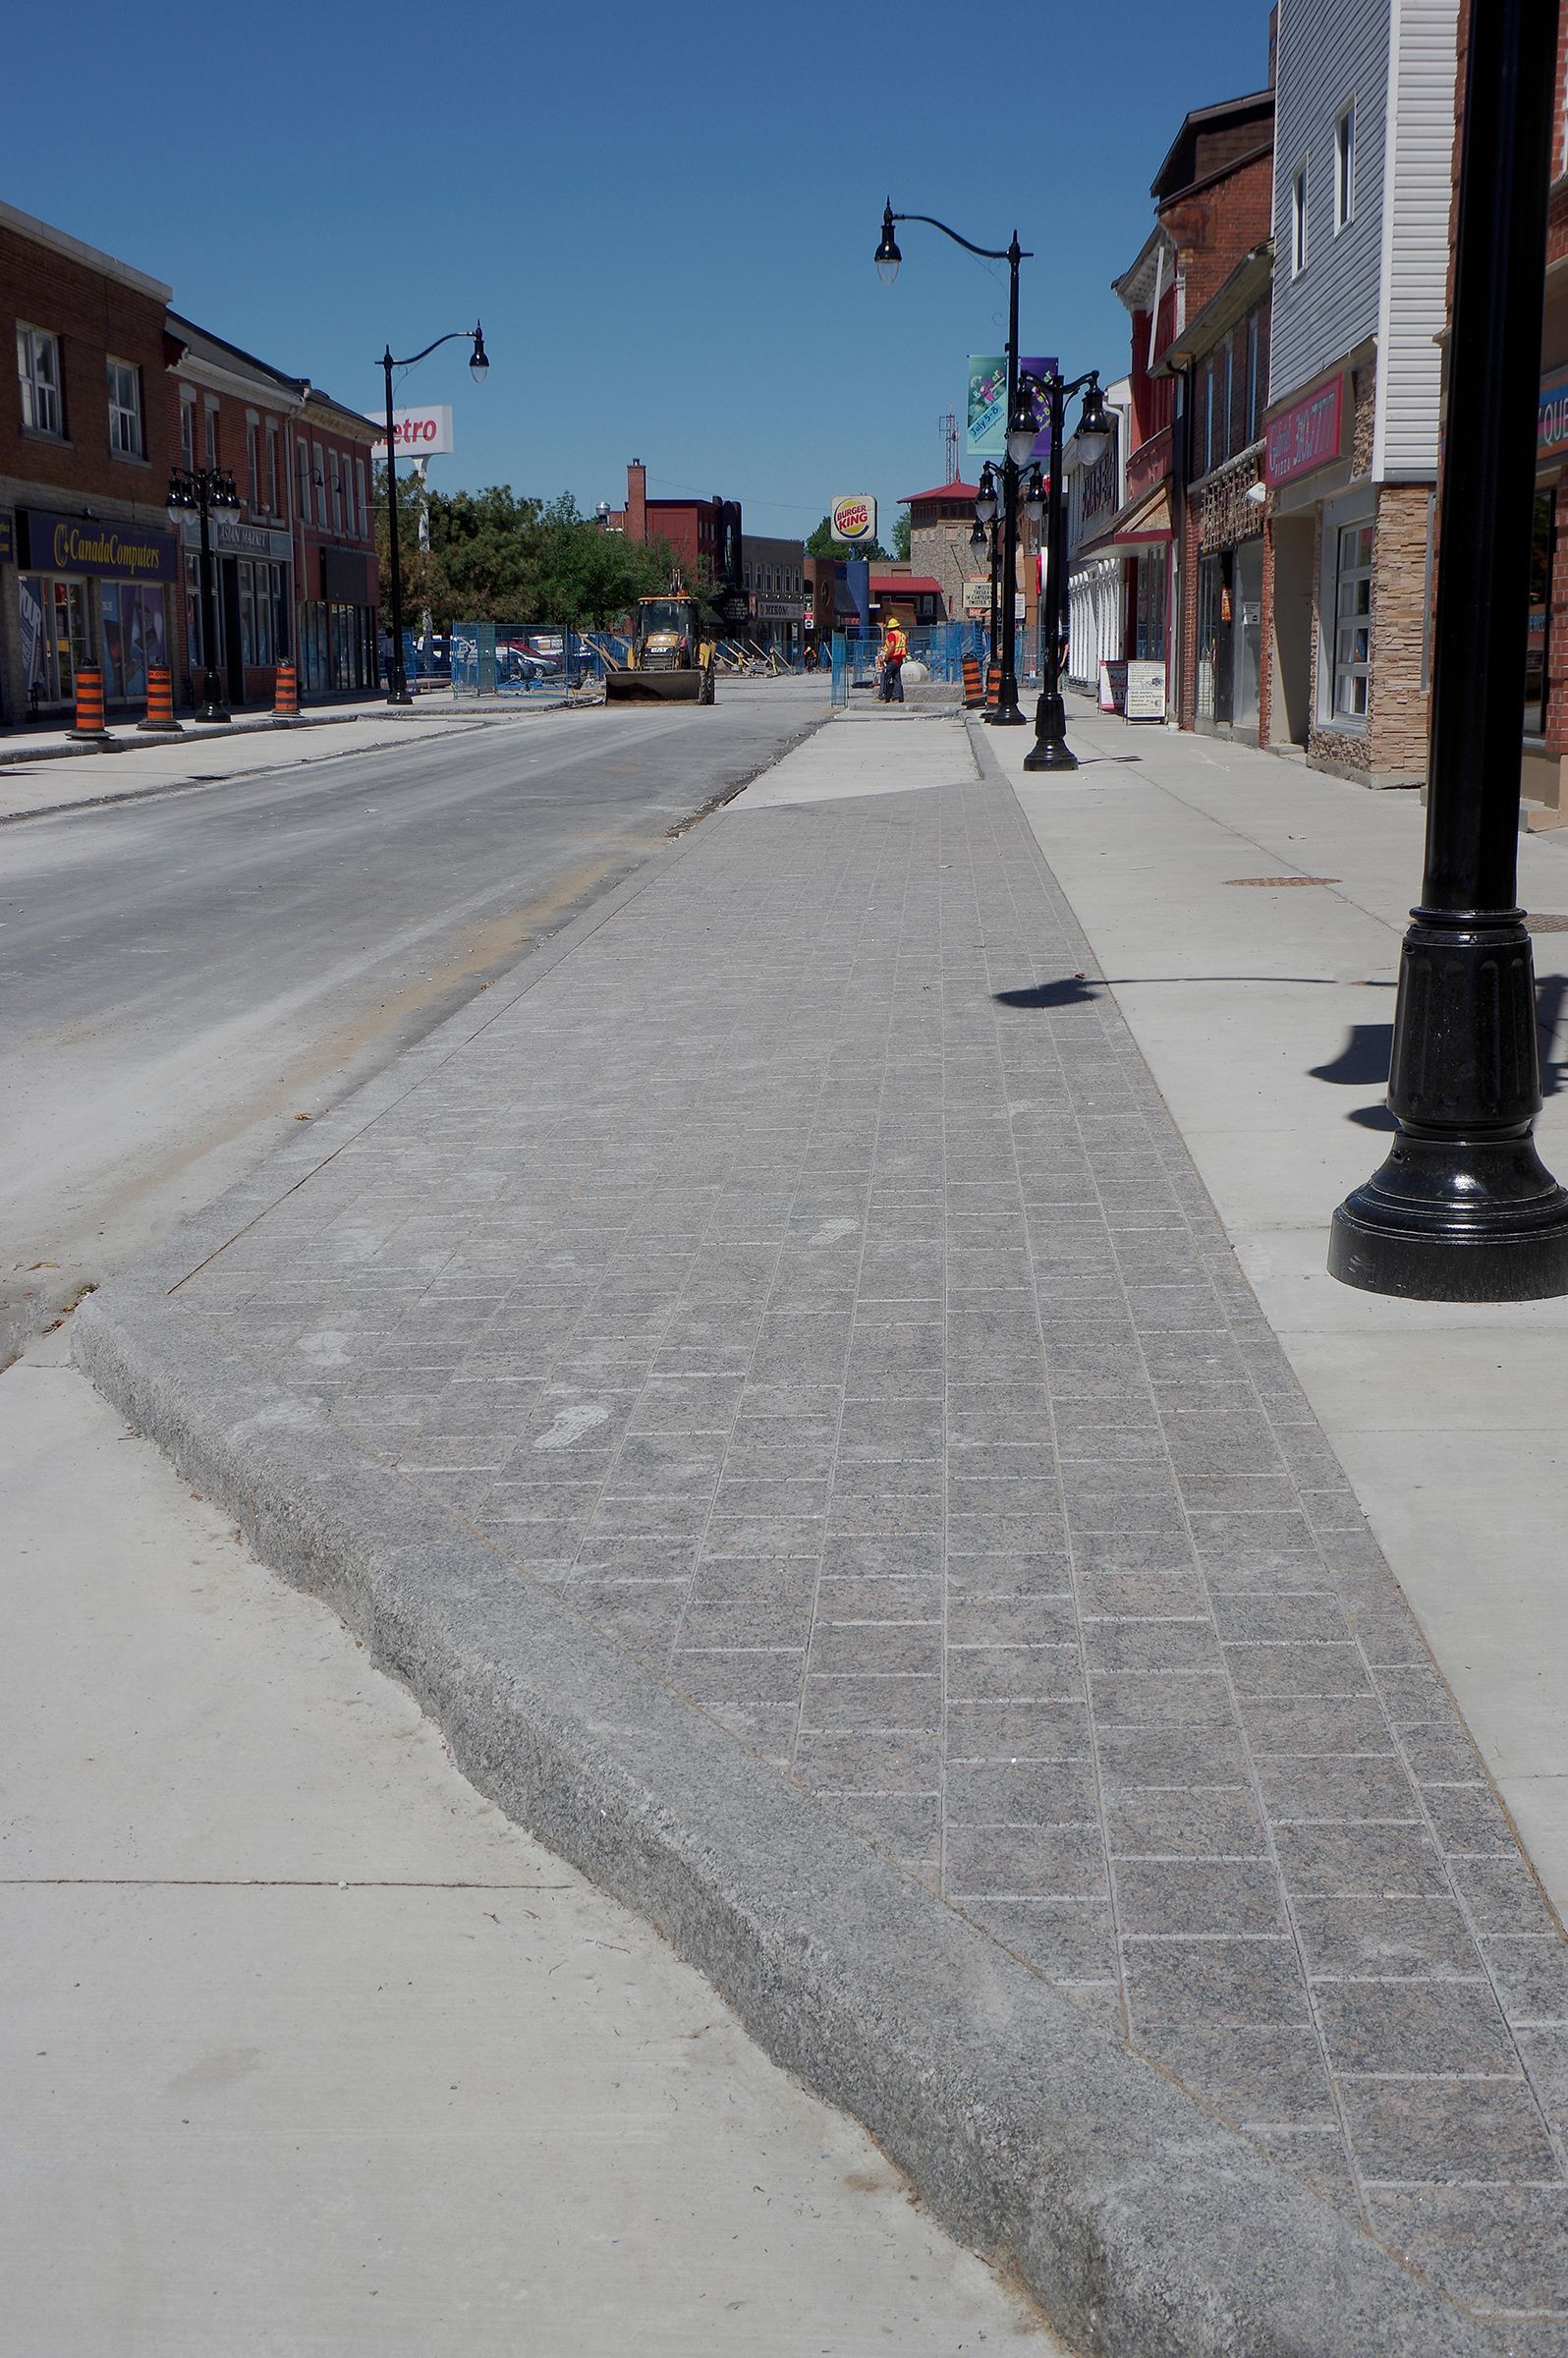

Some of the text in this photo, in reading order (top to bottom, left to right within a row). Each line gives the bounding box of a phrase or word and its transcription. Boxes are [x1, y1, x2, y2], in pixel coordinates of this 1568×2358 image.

[971, 420, 986, 436] July
[984, 407, 998, 422] 5-8
[1036, 408, 1051, 422] 5-8
[1274, 459, 1291, 478] PIZZA
[837, 504, 867, 521] BURGER
[839, 512, 868, 531] KING
